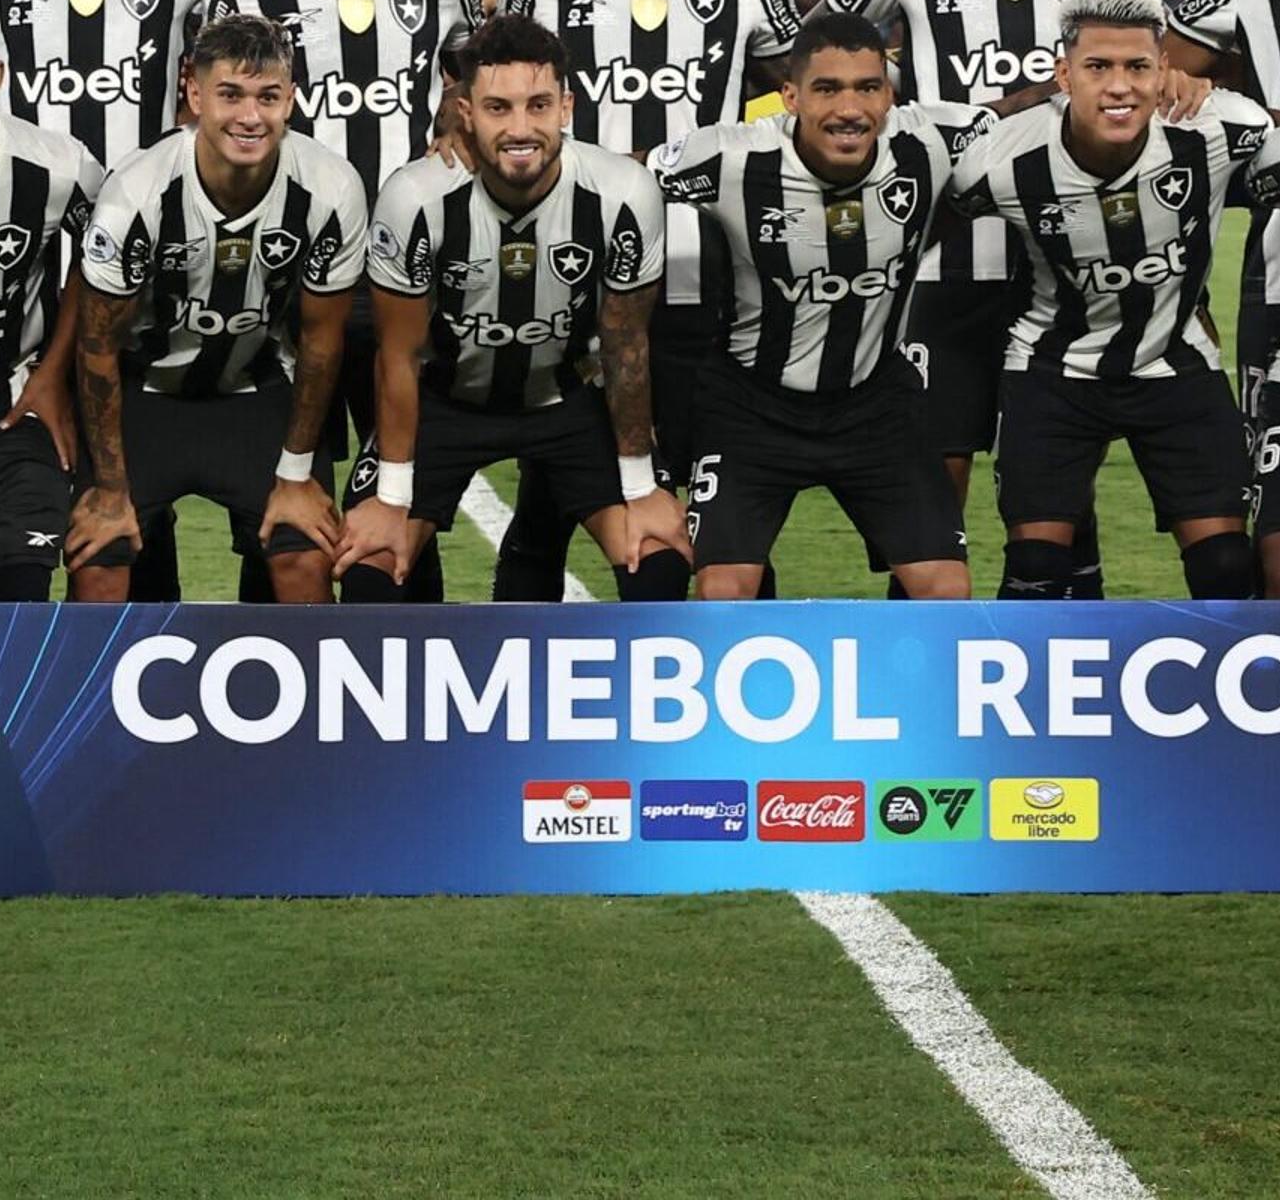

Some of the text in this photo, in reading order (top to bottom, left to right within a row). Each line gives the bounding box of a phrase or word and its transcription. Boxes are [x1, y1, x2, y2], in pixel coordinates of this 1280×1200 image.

[16, 57, 142, 105] vbet
[293, 68, 416, 121] vbet
[576, 56, 707, 104] vbet
[772, 260, 904, 303] vbet
[111, 634, 900, 744] CONMEBOL
[535, 816, 620, 836] AMSTEL
[641, 801, 746, 820] sportingbet
[723, 819, 742, 832] tv
[760, 794, 861, 828] Coca-Cola
[1012, 812, 1076, 825] mercado
[1028, 825, 1060, 838] libre
